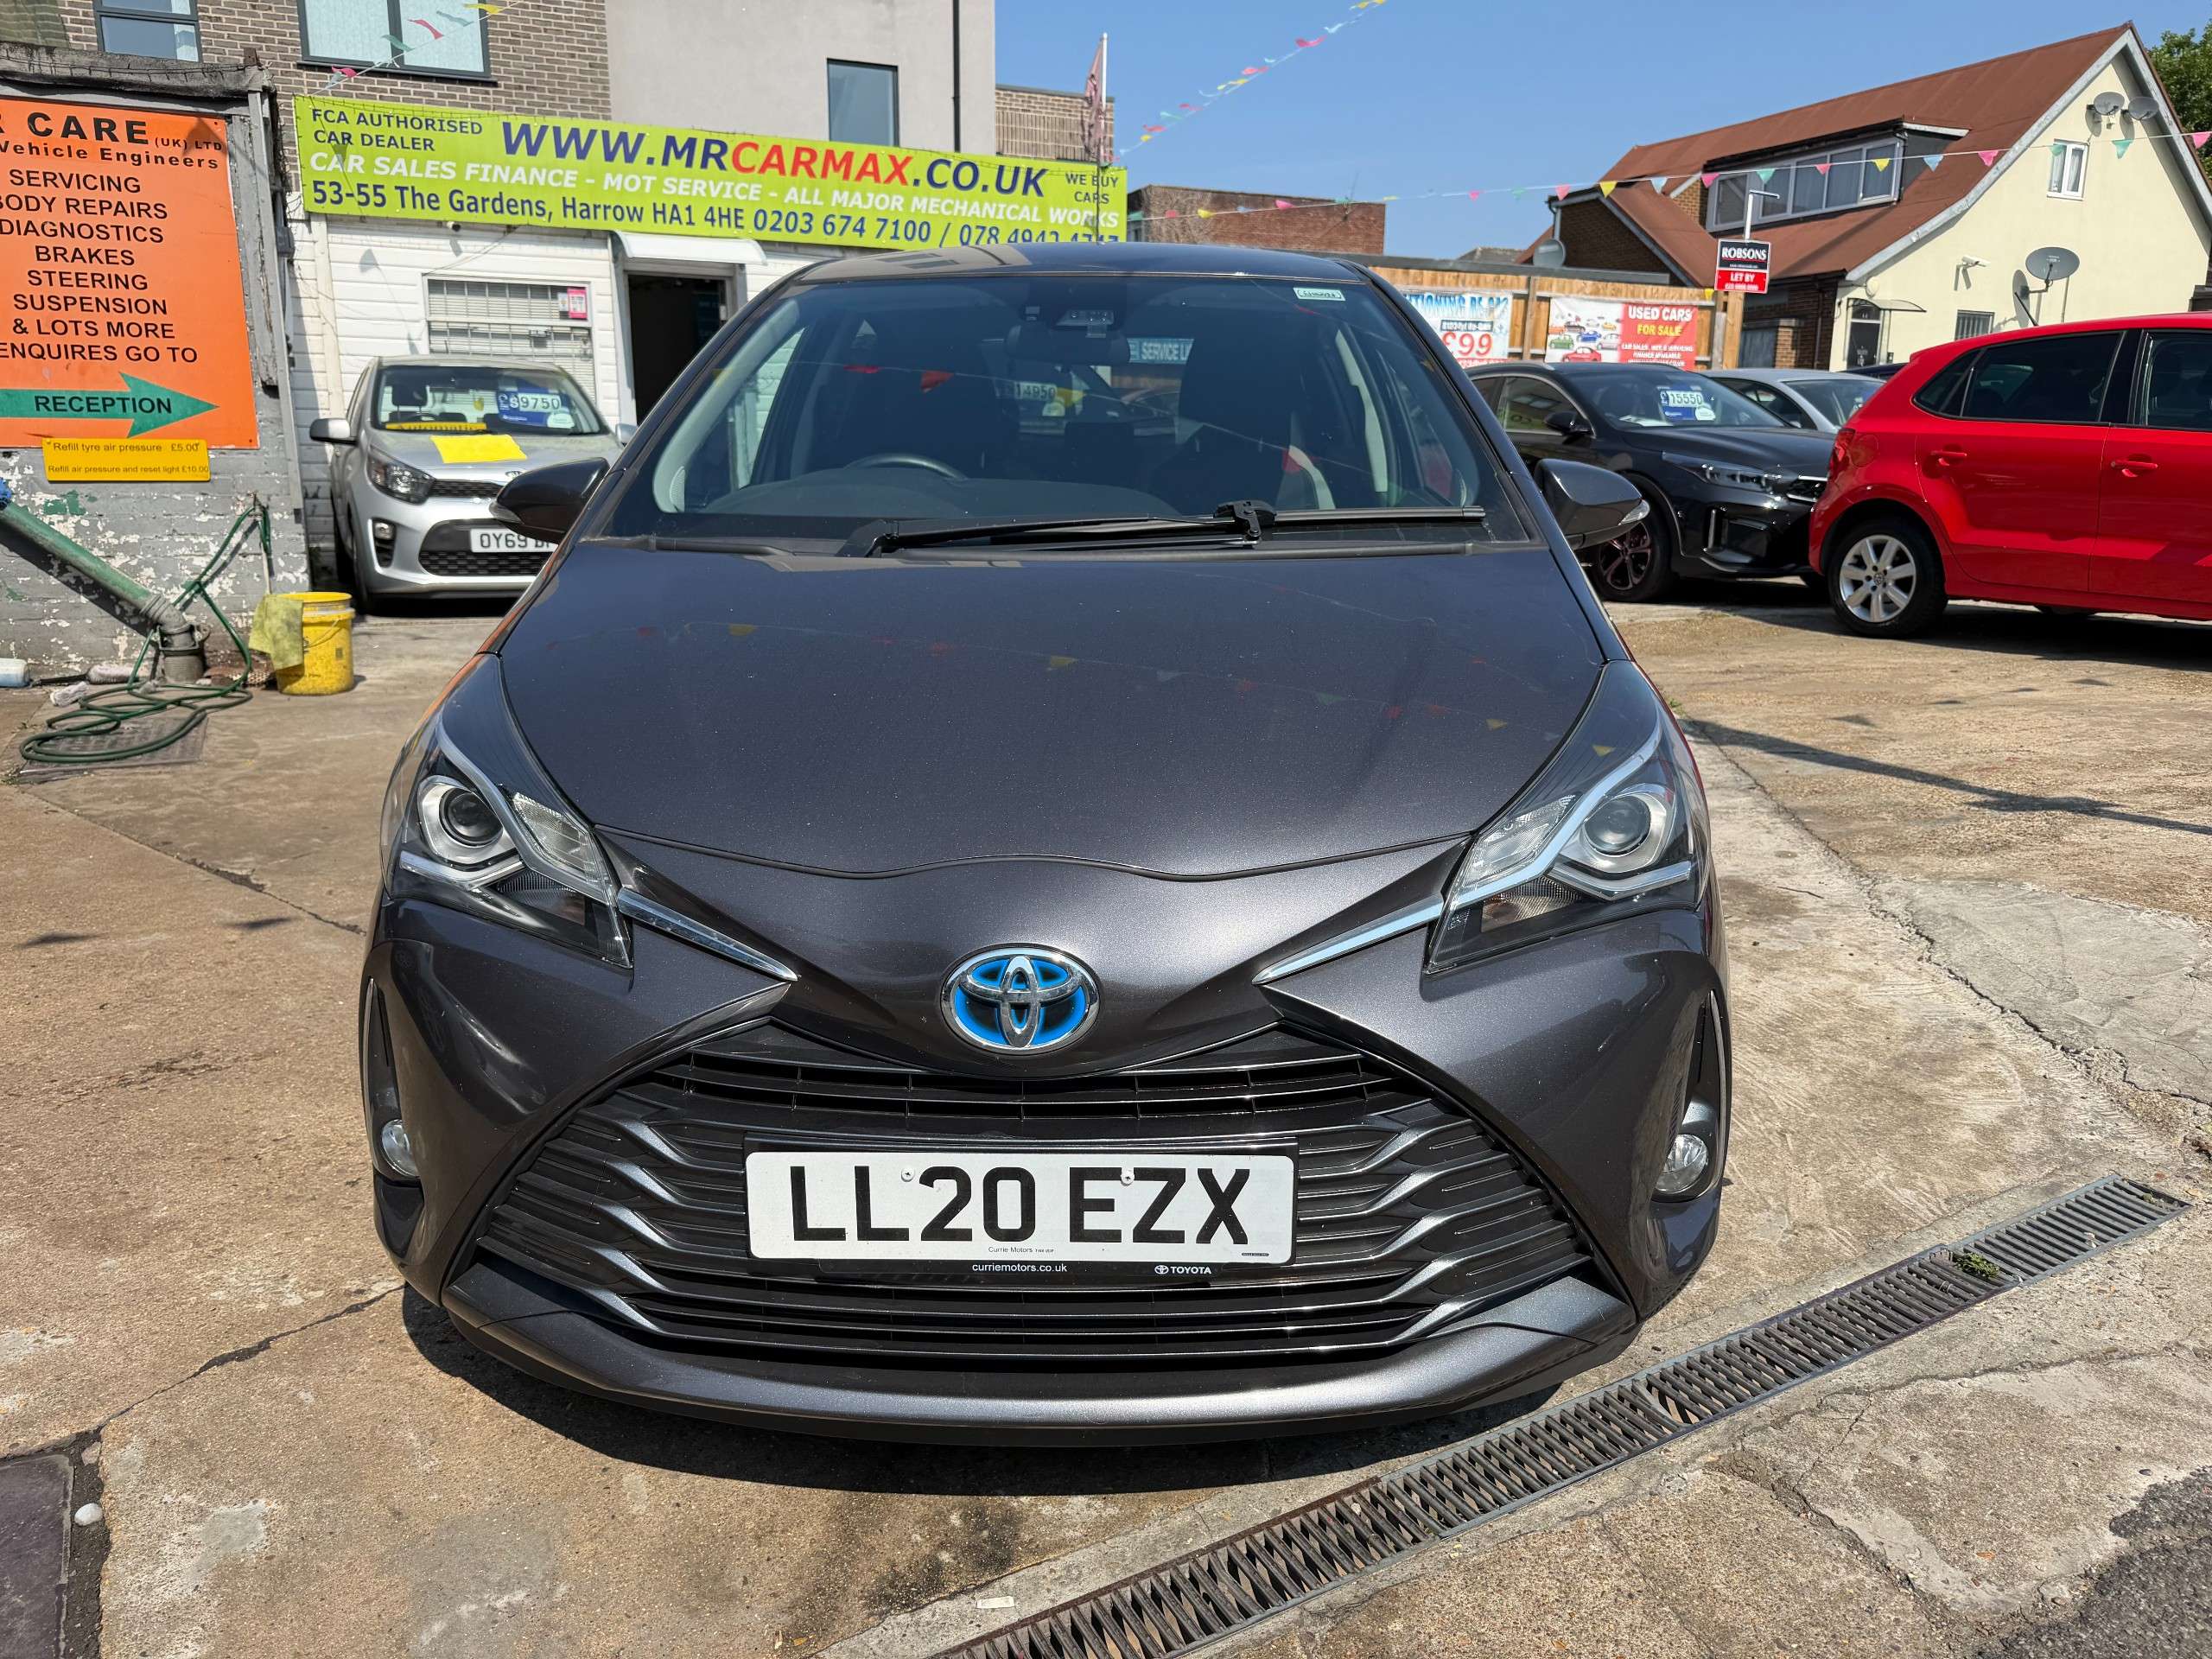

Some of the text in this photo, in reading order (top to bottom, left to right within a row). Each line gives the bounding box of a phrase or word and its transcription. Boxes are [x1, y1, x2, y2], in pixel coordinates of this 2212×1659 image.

[27, 111, 149, 145] CARE
[312, 108, 483, 135] FCA AUTHORISED
[155, 137, 222, 151] (UK) LTD
[314, 130, 435, 151] CAR DEALER
[0, 140, 219, 169] Vehicle Engineers
[502, 121, 1049, 197] WWW.MRCARMAX.CO.UK
[10, 168, 141, 194] SERVICING
[309, 152, 365, 174] CAR
[372, 156, 457, 180] SALES
[464, 162, 578, 188] FINANCE
[603, 173, 657, 194] MOT
[662, 176, 762, 200] SERVICE
[784, 187, 823, 206] ALL
[830, 189, 904, 211] MAJOR
[911, 196, 1042, 222] MECHANICAL
[1048, 207, 1120, 228] WORKS
[1065, 173, 1120, 188] WE BUY
[0, 194, 168, 219] ODY REPAIRS
[1074, 191, 1109, 205] CARS
[312, 180, 387, 208] 53-55
[394, 186, 440, 211] The
[448, 188, 553, 223] Gardens,
[562, 196, 645, 223] Harrow
[652, 201, 695, 226] HA1
[703, 206, 744, 230] 4HE
[753, 208, 814, 235] 0203
[823, 213, 866, 238] 674
[874, 217, 931, 243] 7100
[959, 224, 999, 246] 078
[0, 219, 164, 244] DIAGNOSTICS
[35, 245, 136, 266] BRAKES
[1721, 246, 1767, 260] ROBSONS
[27, 270, 149, 291] STEERING
[1730, 272, 1755, 283] LET BY
[13, 294, 168, 315] SUSPENSION
[1628, 304, 1693, 322] USED CARS
[12, 318, 175, 340] & LOTS MORE
[1637, 324, 1683, 337] FOR SALE
[0, 342, 198, 363] ENQUIRES GO TO
[34, 395, 172, 414] RECEPTION
[53, 442, 79, 451] Refill
[81, 443, 100, 453] tyre
[104, 442, 117, 451] air
[119, 444, 162, 453] pressure
[162, 465, 180, 474] light
[480, 533, 528, 548] OY69
[790, 1165, 1251, 1245] LL20 EZX
[972, 1262, 1067, 1272] curriemotors.co.uk
[1170, 1266, 1211, 1274] TOYOTA
